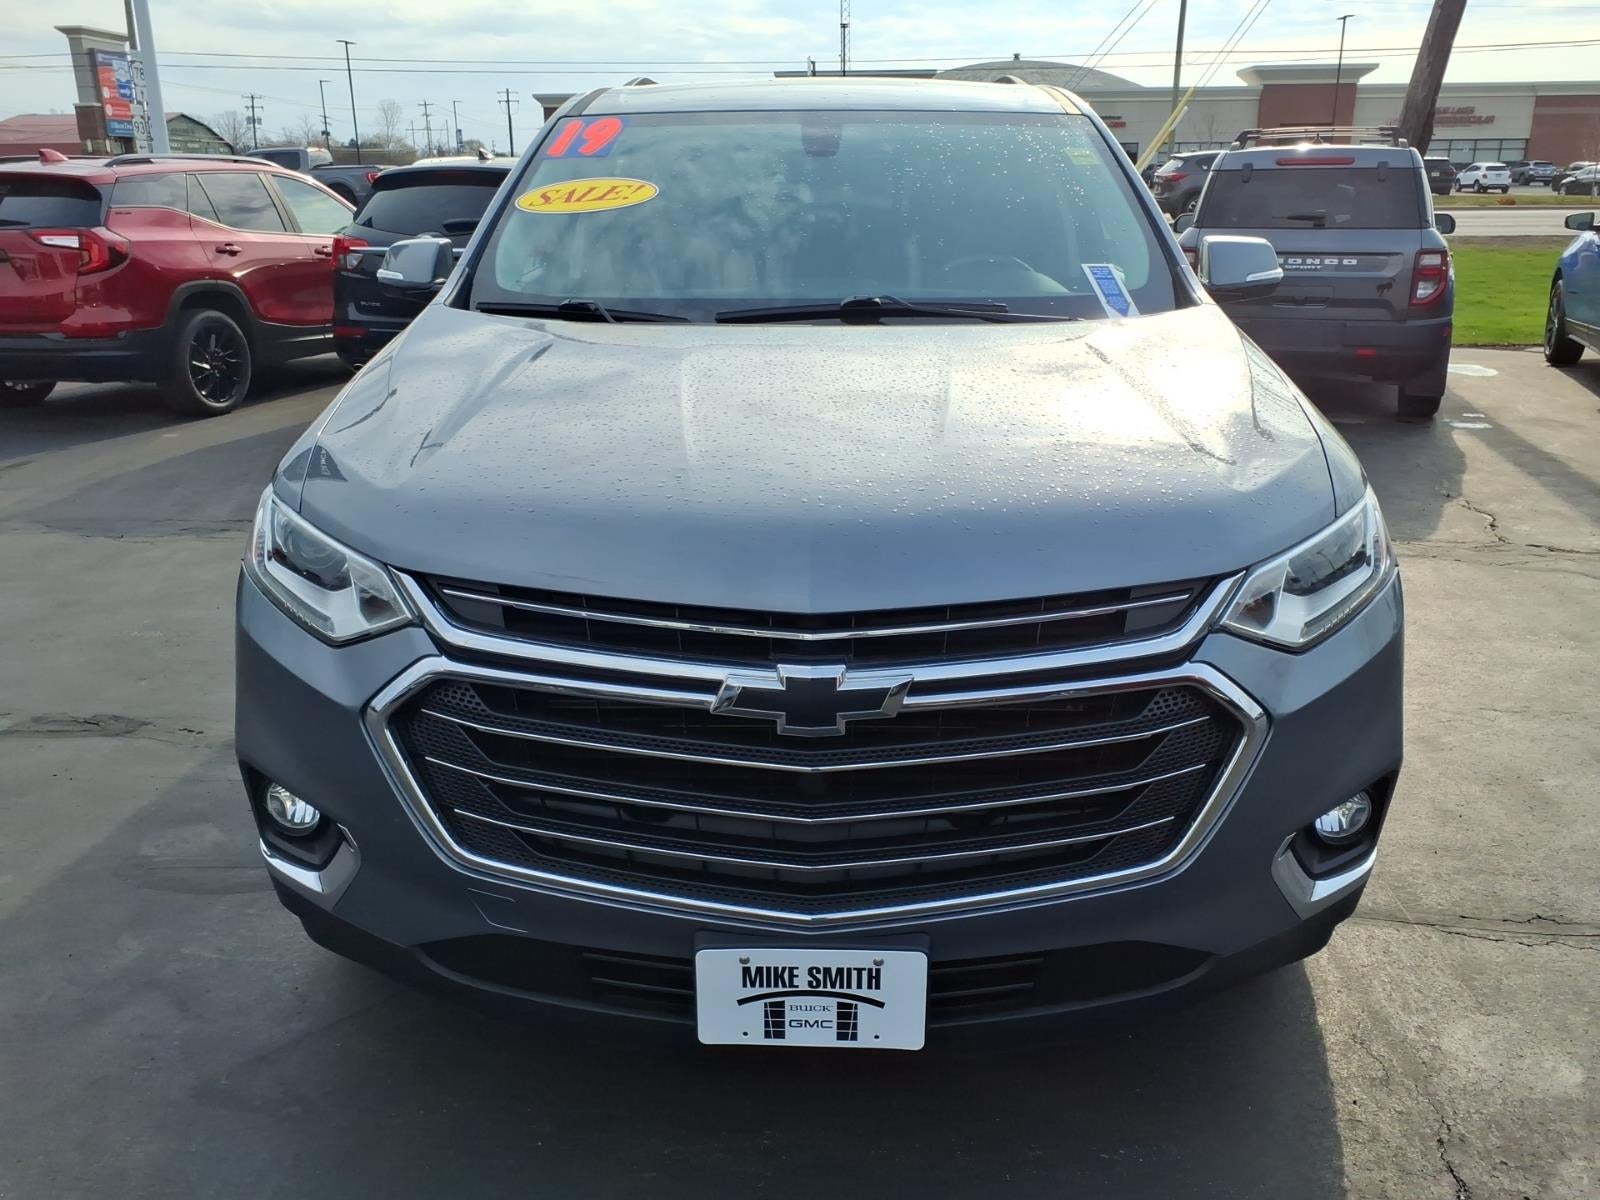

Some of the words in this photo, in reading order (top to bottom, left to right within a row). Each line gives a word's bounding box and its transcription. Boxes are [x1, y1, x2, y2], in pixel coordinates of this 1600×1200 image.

[133, 66, 146, 81] 78
[134, 121, 146, 135] 93
[547, 117, 623, 157] 19
[528, 184, 647, 207] SALE!
[1278, 258, 1358, 266] ONCO
[742, 966, 799, 988] MIKE
[807, 967, 881, 990] SMITH
[789, 1004, 832, 1012] BUICK
[788, 1019, 833, 1029] GMC
